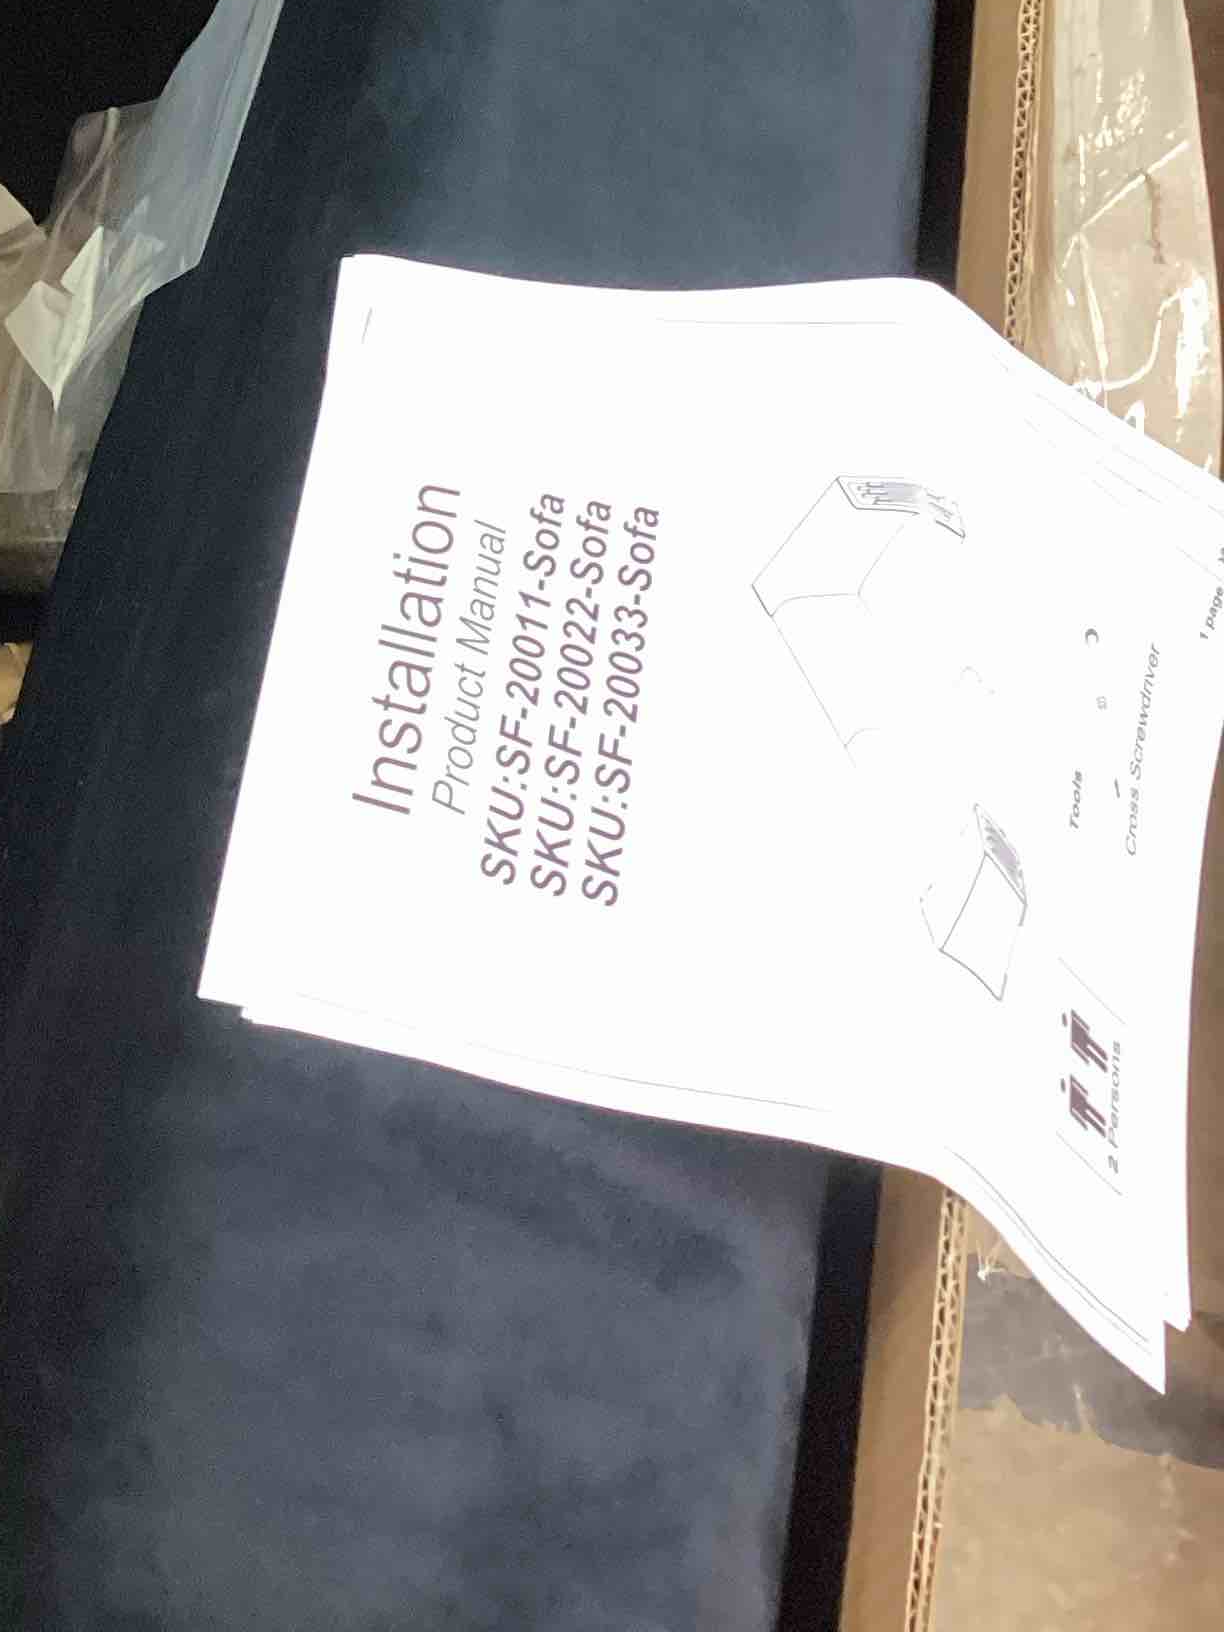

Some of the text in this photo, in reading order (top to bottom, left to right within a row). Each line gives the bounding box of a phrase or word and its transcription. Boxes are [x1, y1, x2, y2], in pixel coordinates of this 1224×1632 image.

[352, 485, 461, 815] Installation
[432, 519, 507, 815] Product Manual
[480, 493, 565, 885] SKU:SF-20011-Sofa
[530, 500, 612, 896] SKU:SF-20022-Sofa
[581, 506, 660, 906] SKU:SF-20033-Sofa
[1069, 770, 1083, 830] Tools
[1125, 643, 1160, 857] Cross Screwdriver
[1108, 1041, 1121, 1148] Persons
